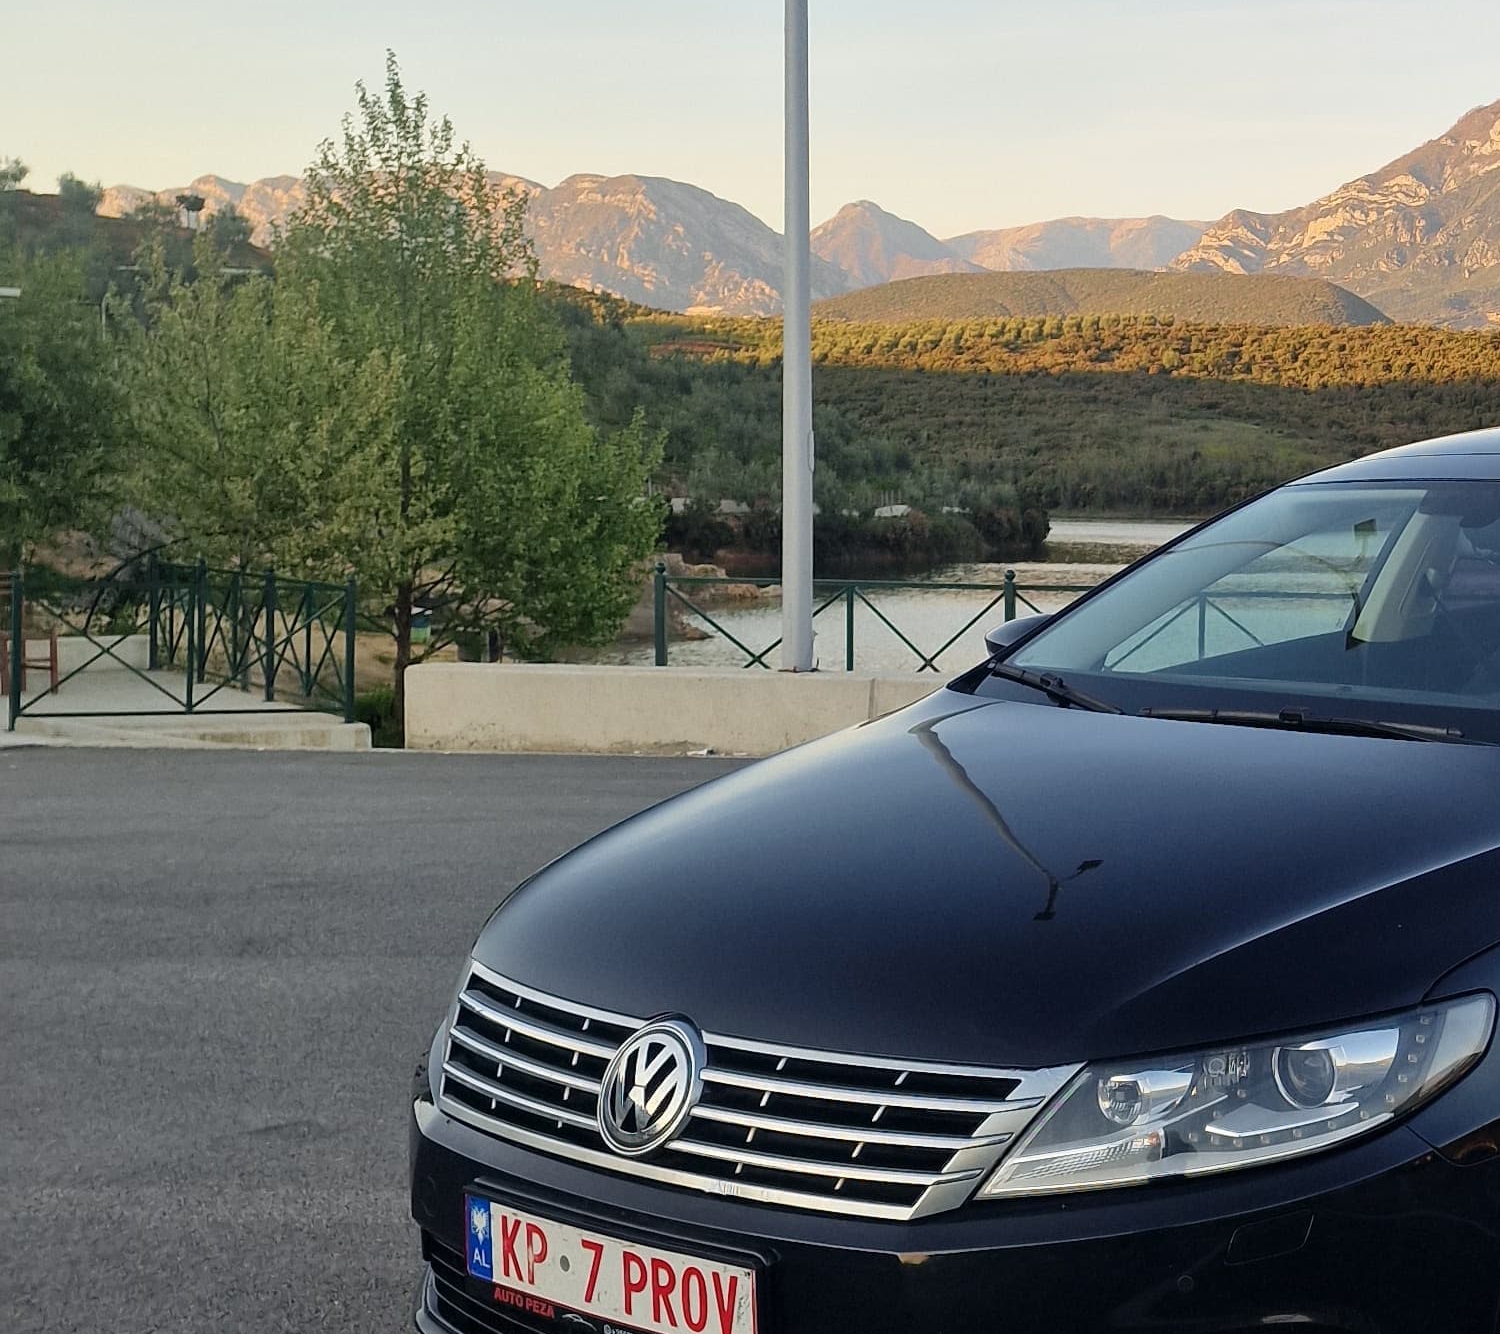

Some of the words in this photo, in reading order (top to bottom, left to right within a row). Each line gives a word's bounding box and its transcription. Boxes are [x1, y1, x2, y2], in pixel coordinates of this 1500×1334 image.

[472, 1247, 491, 1269] AL
[501, 1214, 548, 1285] KP
[580, 1238, 604, 1304] 7
[494, 1287, 524, 1309] AUTO
[525, 1296, 555, 1320] PEZA
